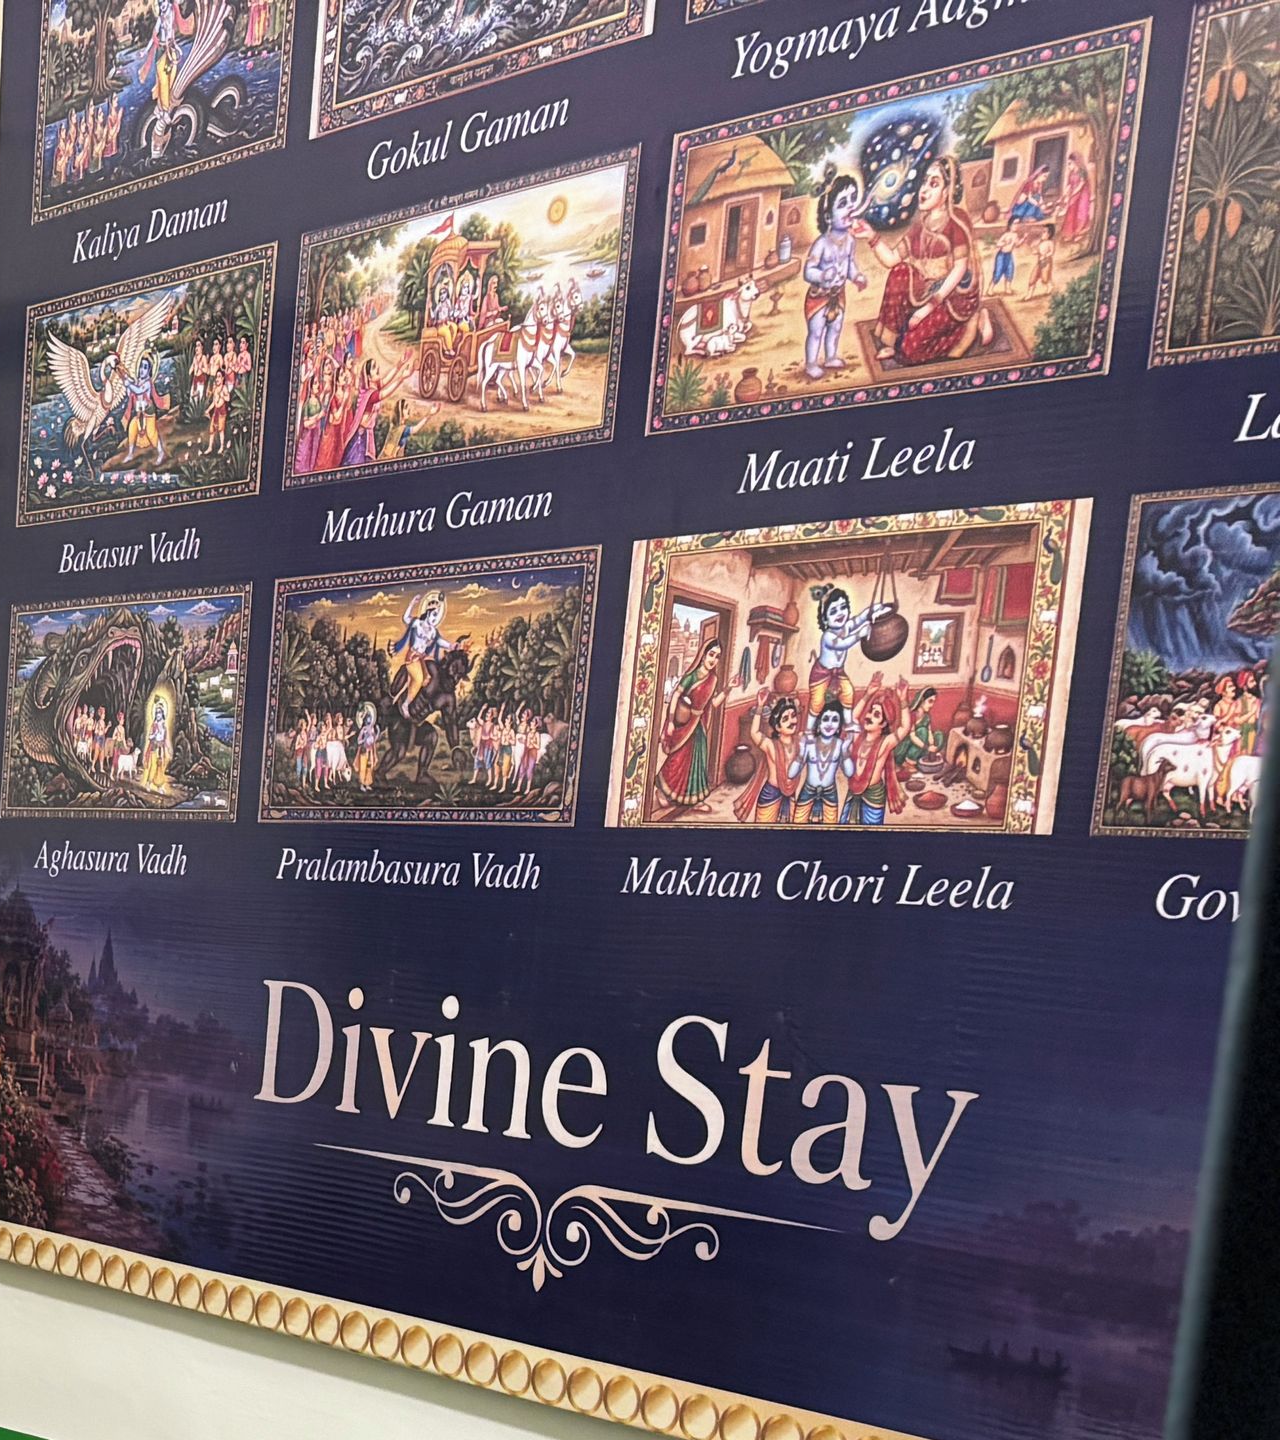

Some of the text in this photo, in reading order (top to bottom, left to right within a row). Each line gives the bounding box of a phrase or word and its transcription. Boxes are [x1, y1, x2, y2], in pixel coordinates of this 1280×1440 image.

[730, 6, 901, 80] Yogmaya
[367, 98, 569, 180] Gokul Gaman
[72, 199, 228, 264] Kaliya Daman
[736, 427, 976, 494] Maati Leela
[320, 491, 553, 544] Mathura Gaman
[58, 527, 201, 574] Bakasur Vadh
[33, 840, 187, 878] Aghasura Vadh
[276, 848, 540, 890] Pralambasura Vadh
[620, 857, 1014, 910] Makhan Chori Leela
[253, 979, 607, 1153] Divine
[645, 1014, 980, 1242] Stay
